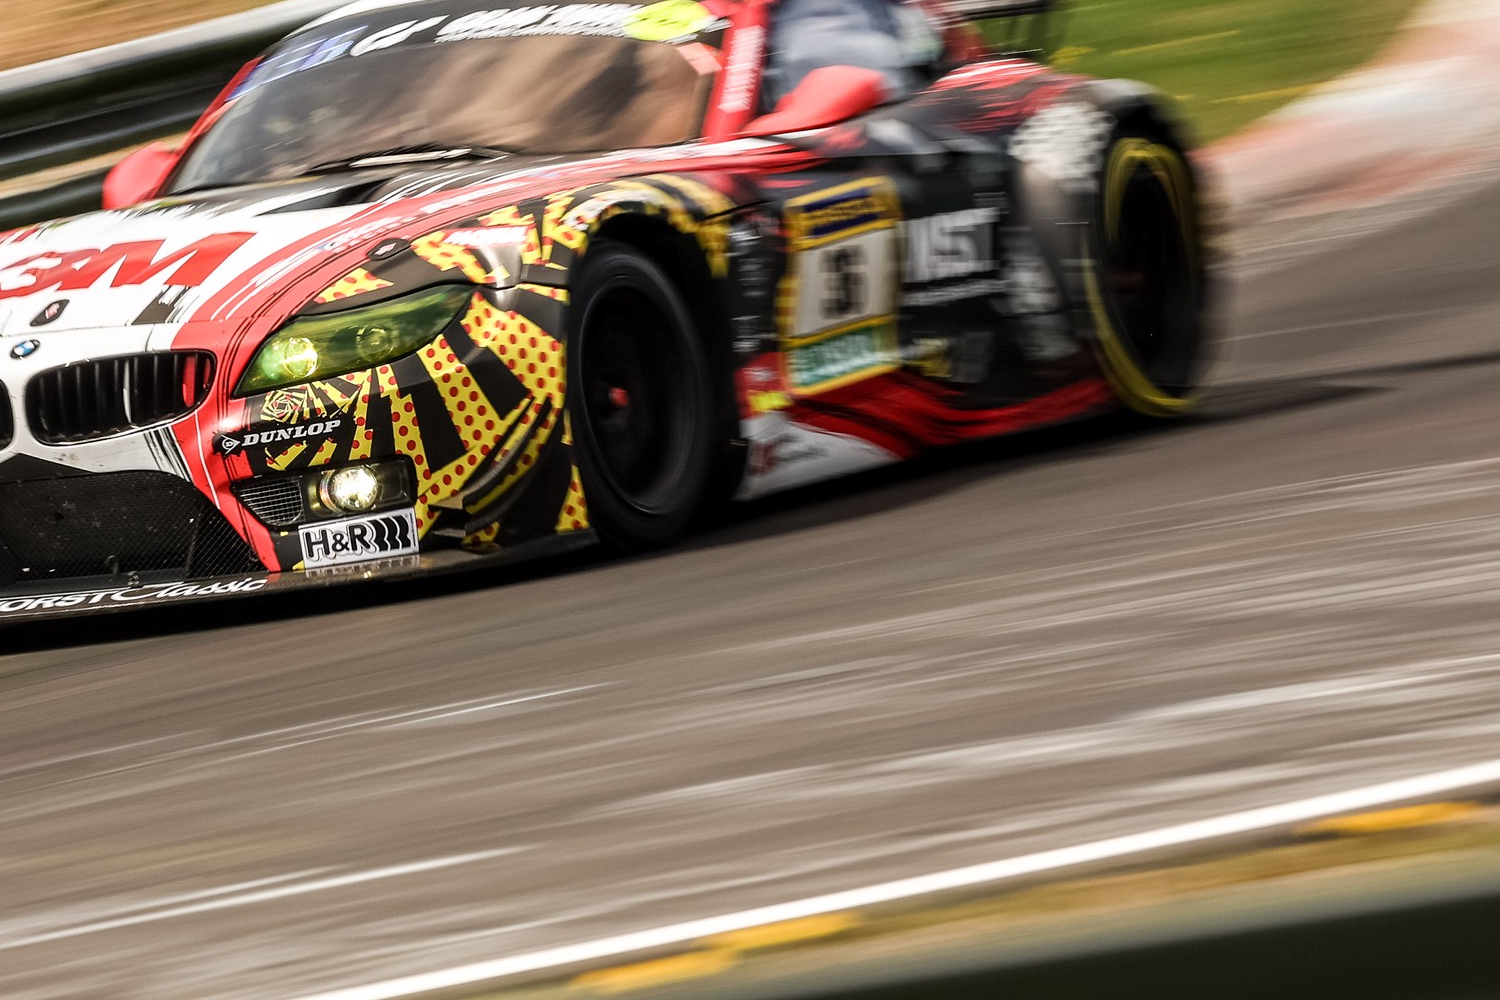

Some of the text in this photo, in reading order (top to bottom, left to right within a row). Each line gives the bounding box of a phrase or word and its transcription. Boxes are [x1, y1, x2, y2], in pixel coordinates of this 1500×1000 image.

[241, 419, 341, 447] DUNLOP
[304, 522, 372, 559] H&R
[111, 577, 268, 601] Classic
